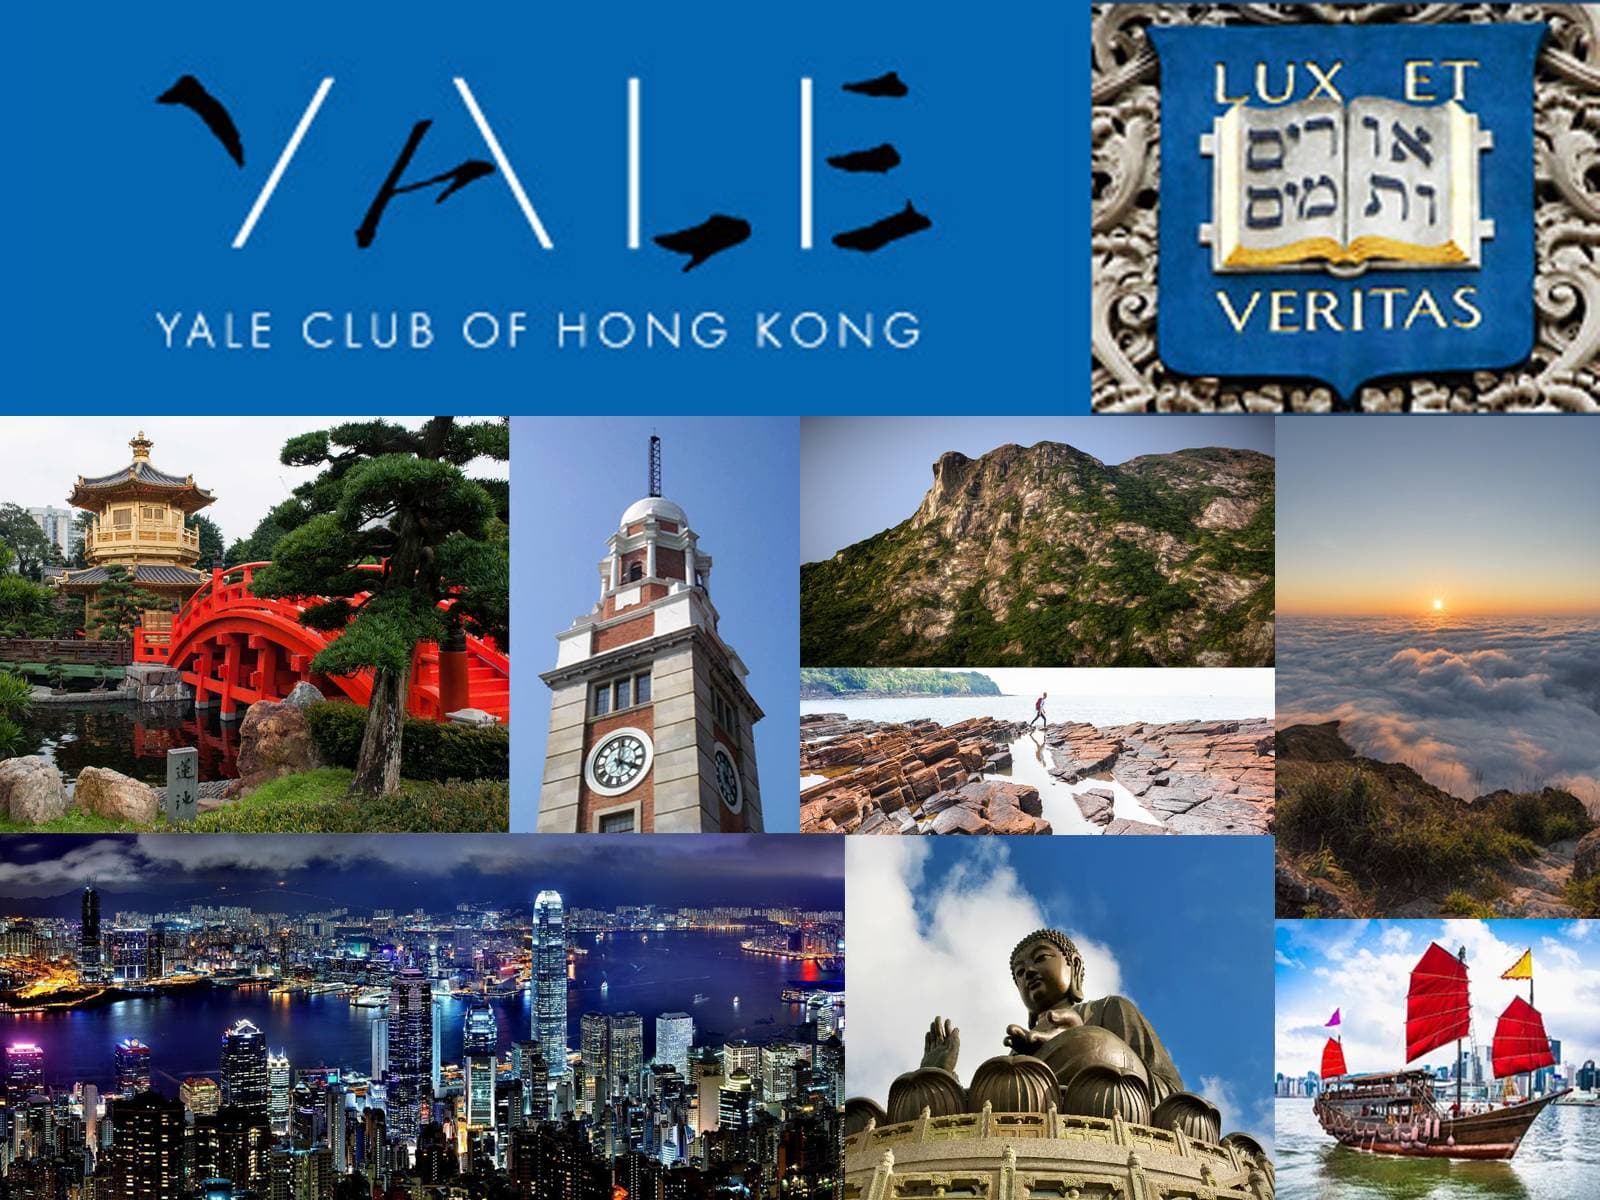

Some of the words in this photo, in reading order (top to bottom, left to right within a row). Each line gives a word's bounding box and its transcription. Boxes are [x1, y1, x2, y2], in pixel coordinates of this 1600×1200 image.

[1215, 62, 1343, 106] LUX
[1405, 61, 1478, 101] ET
[1216, 286, 1482, 333] VERITAS
